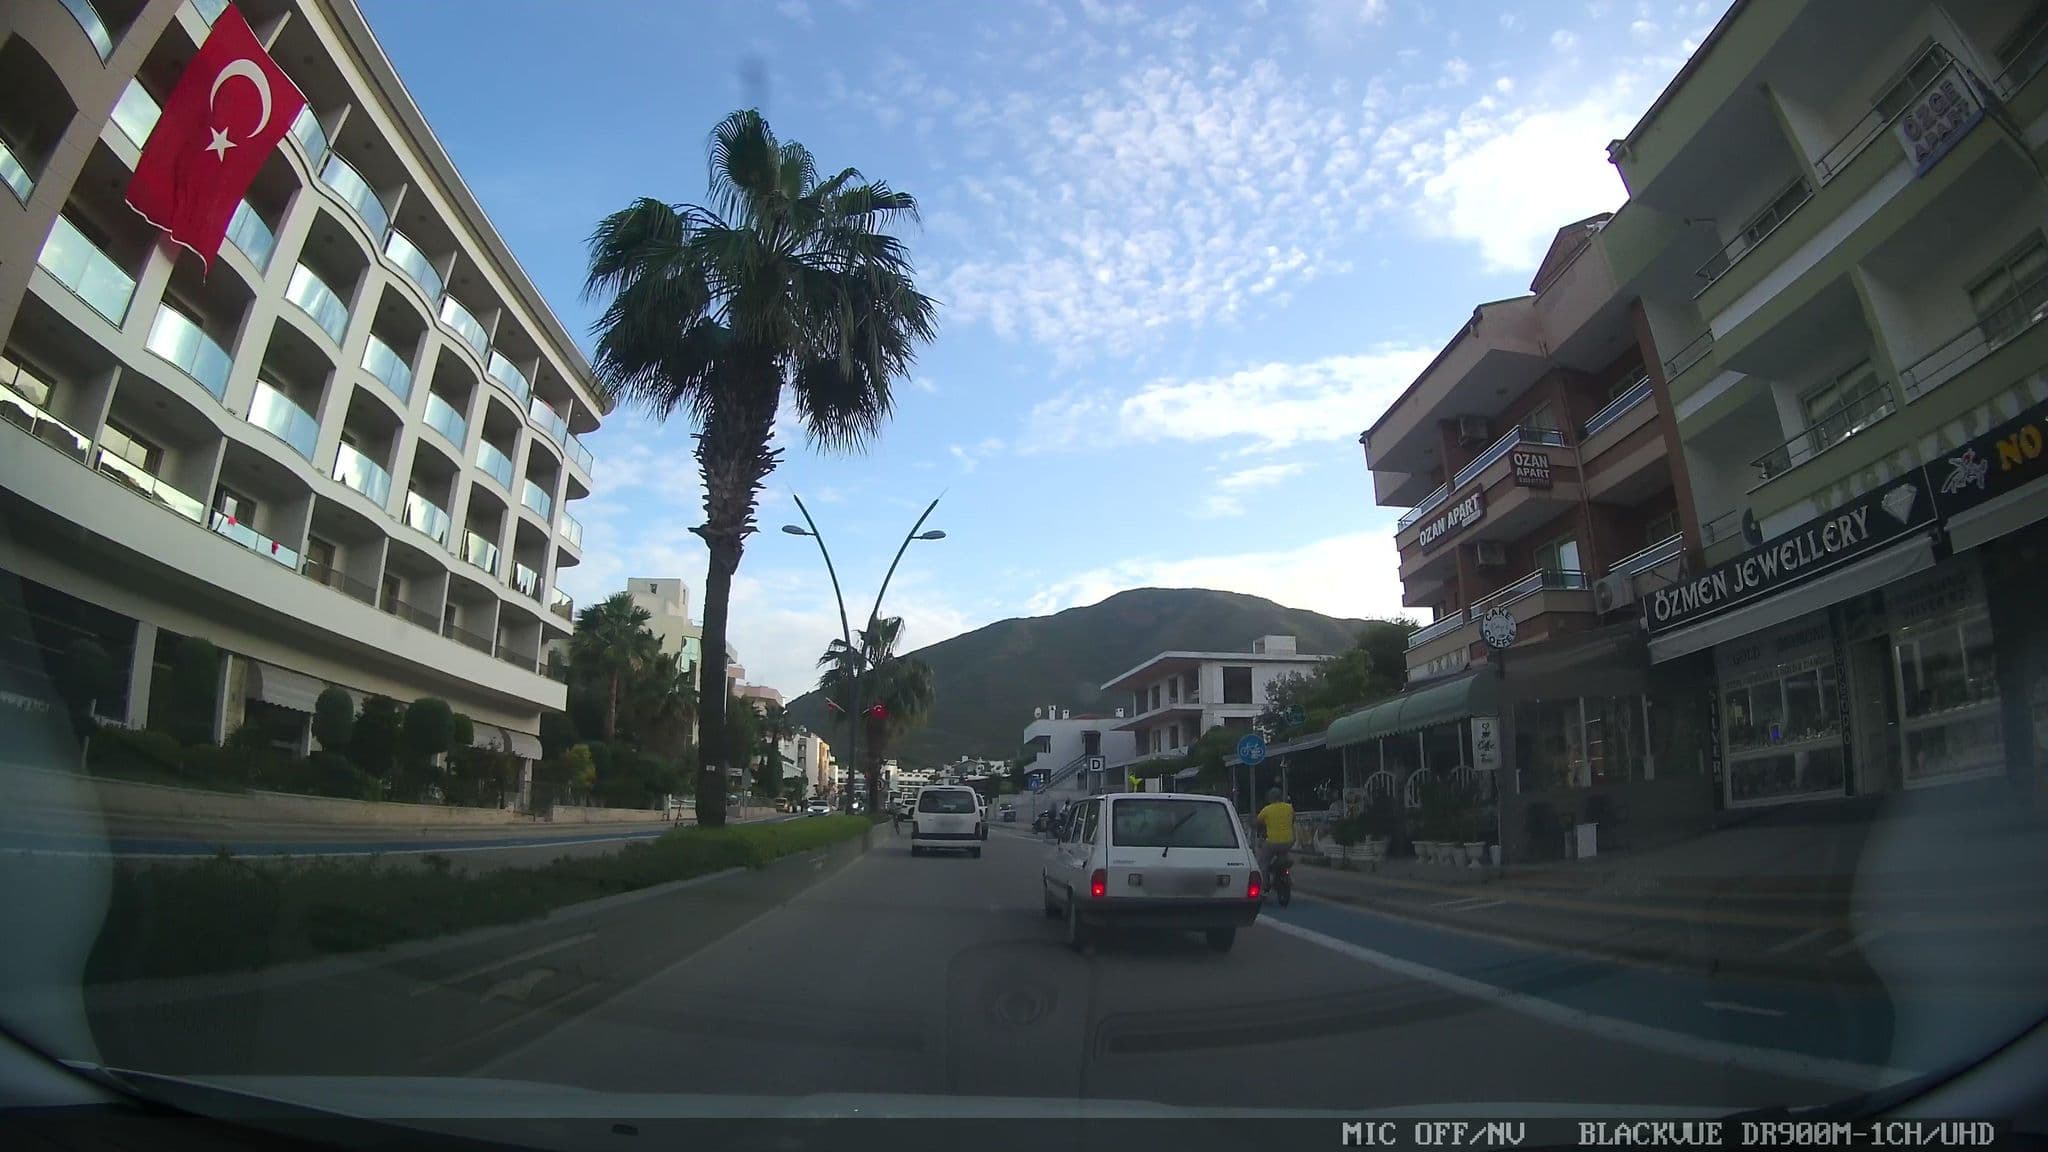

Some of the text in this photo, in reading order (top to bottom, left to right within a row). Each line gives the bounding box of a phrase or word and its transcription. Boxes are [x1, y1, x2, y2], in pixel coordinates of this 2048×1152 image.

[1513, 453, 1549, 468] OZAN
[1516, 467, 1550, 479] APART
[1419, 516, 1446, 546] OZAN
[1447, 493, 1481, 529] APART
[1654, 505, 1870, 621] ÖZMEN JEWELLERY
[1485, 607, 1512, 621] CAKE
[1485, 630, 1515, 647] COFFEE
[1092, 759, 1101, 770] D
